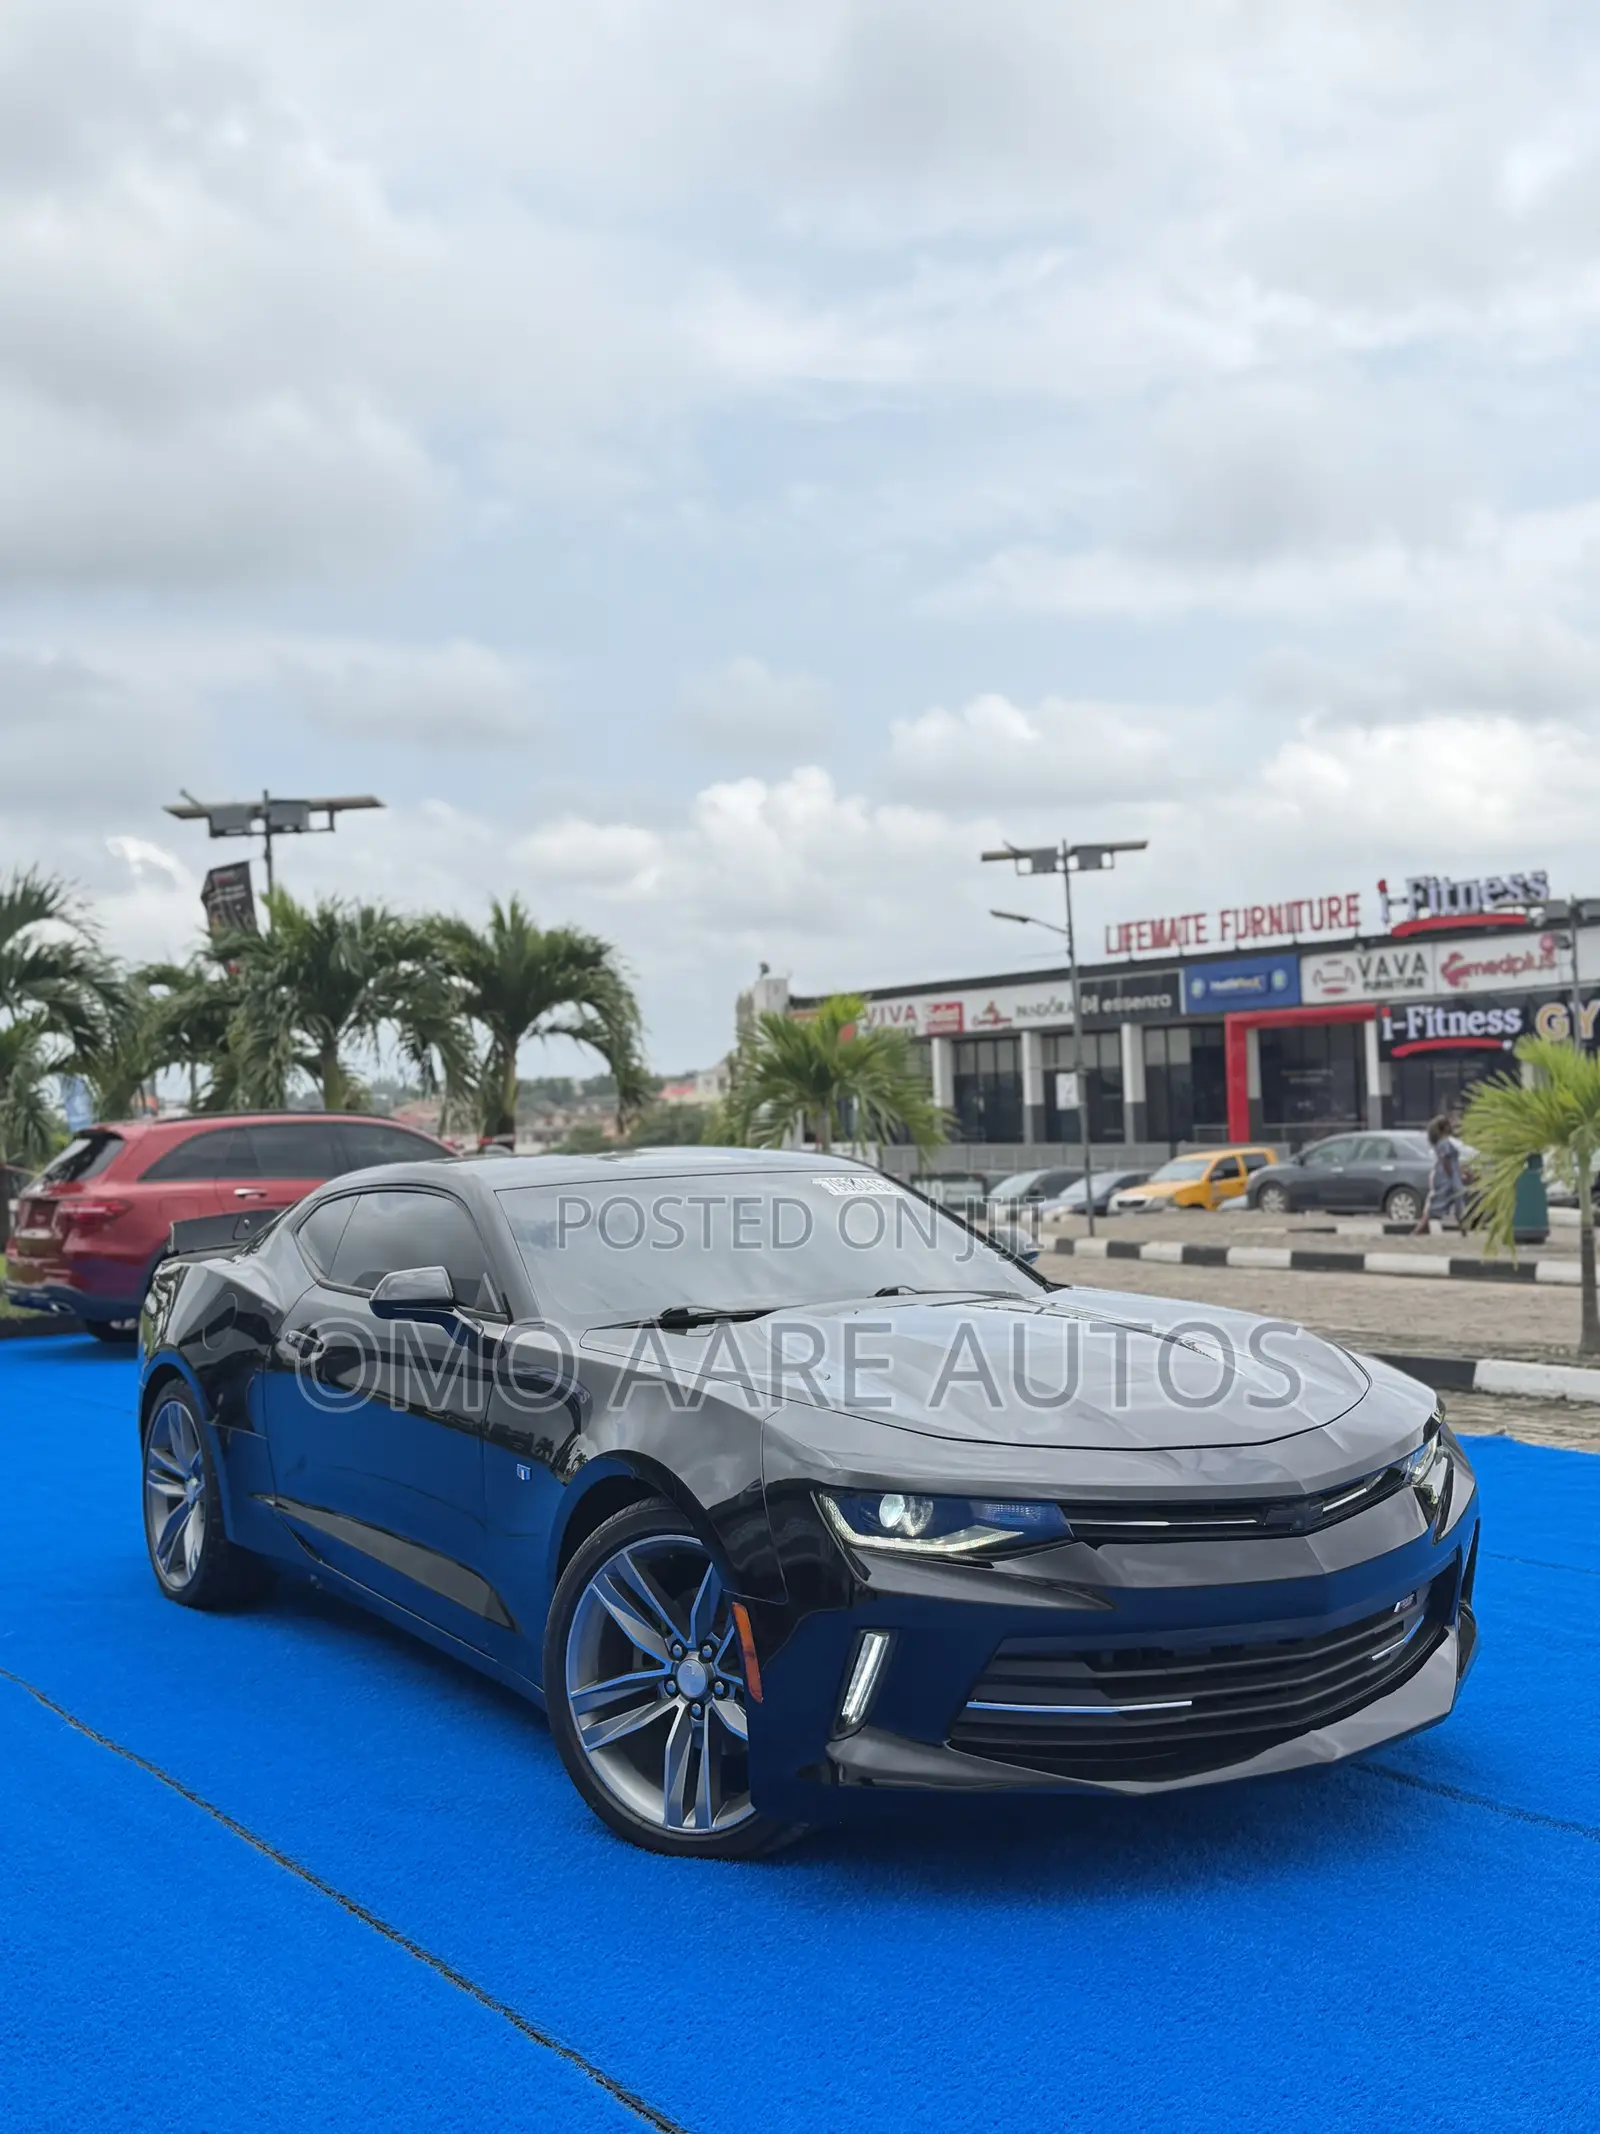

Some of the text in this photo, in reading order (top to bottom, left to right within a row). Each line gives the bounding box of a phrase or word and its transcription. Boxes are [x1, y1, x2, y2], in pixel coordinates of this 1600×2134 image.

[1105, 892, 1361, 955] LIFEMATE FURNITURE
[1357, 951, 1428, 978] VAVA
[1380, 1003, 1522, 1041] i-Fitness
